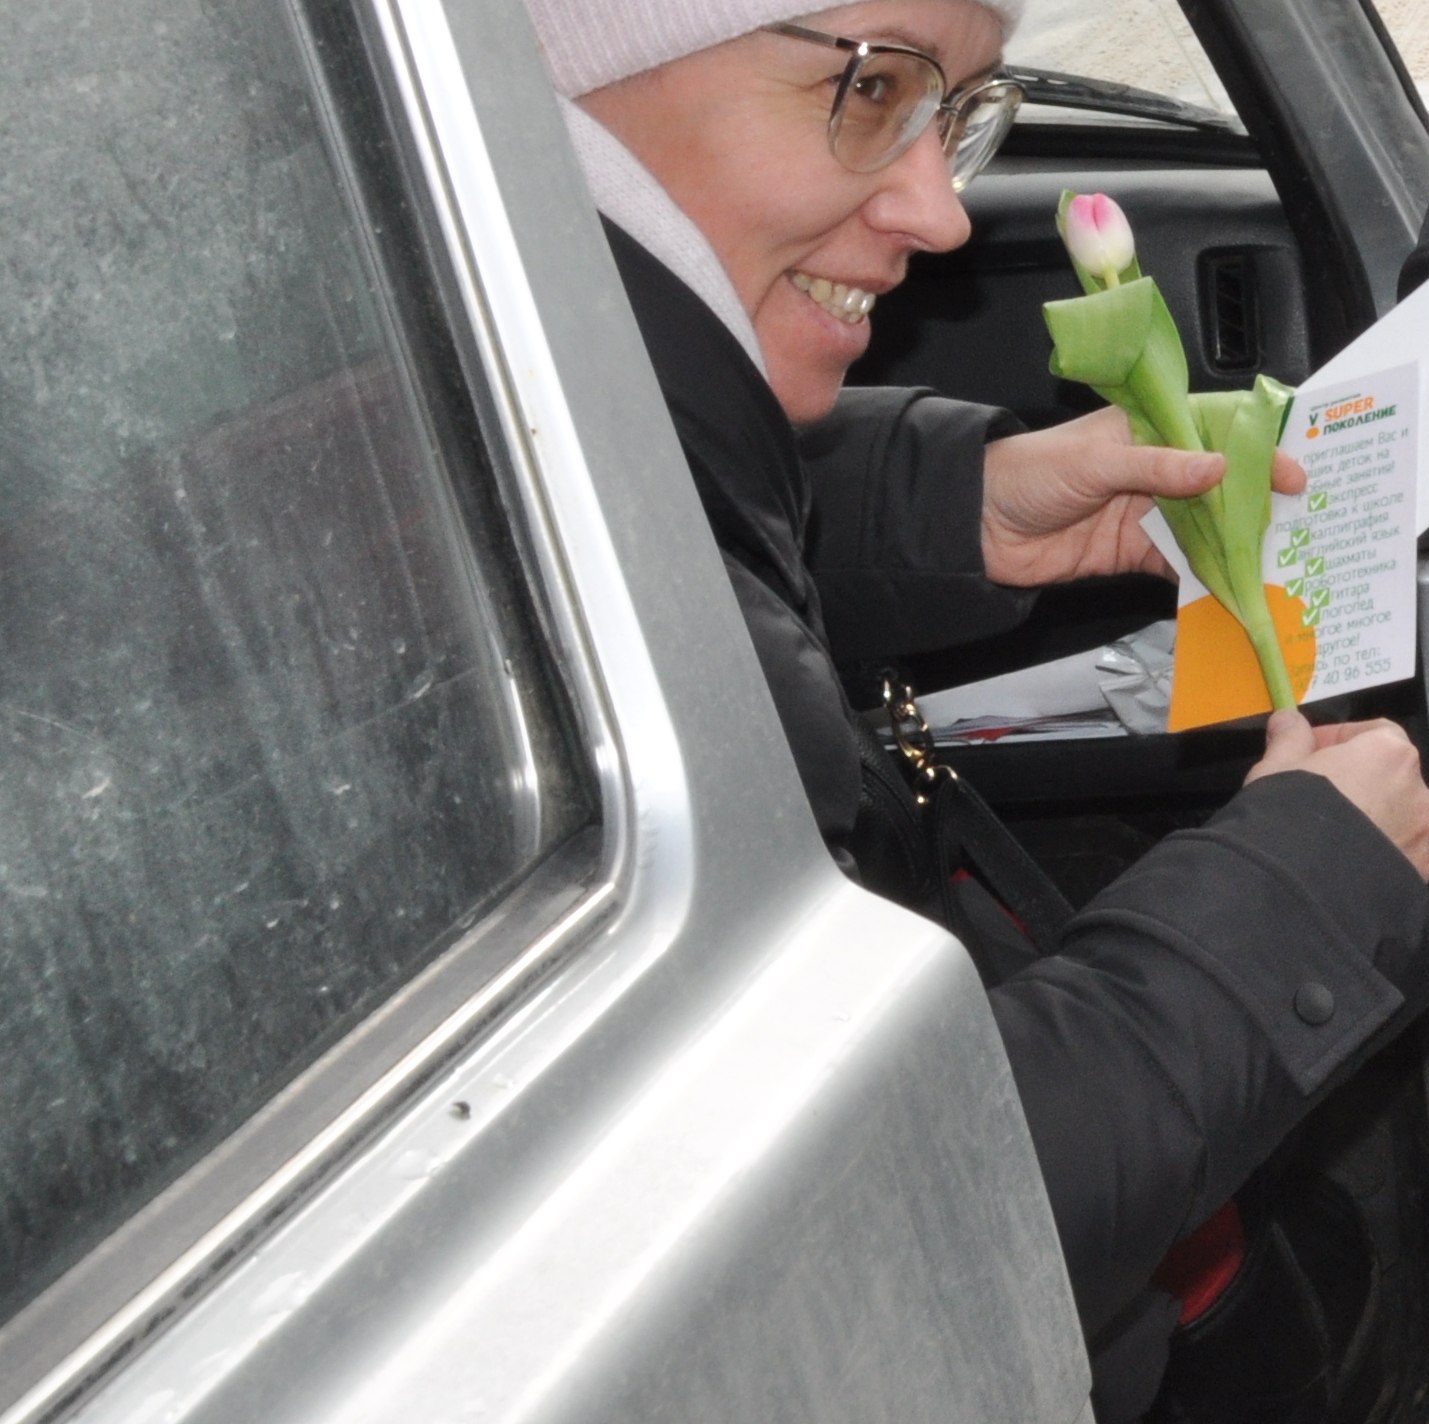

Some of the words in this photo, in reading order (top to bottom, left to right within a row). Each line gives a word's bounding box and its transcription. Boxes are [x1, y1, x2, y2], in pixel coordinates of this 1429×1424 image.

[1323, 404, 1397, 435] ПОКОЛЕНИЕ
[1324, 396, 1374, 422] SUPER
[1303, 437, 1374, 466] приглашаем
[1378, 430, 1397, 444] Вас
[1401, 428, 1409, 439] и
[1306, 465, 1333, 479] аших
[1338, 453, 1373, 475] деток
[1377, 448, 1390, 460] на
[1347, 460, 1395, 483] занятия!
[1328, 482, 1378, 505] экспресс
[1275, 506, 1347, 534] подготовка
[1352, 504, 1358, 514] к
[1363, 492, 1404, 512] школе
[1311, 511, 1389, 540] каллиграфия
[1297, 533, 1367, 561] английский
[1372, 526, 1400, 541] язык
[1325, 549, 1377, 570] шахматы
[1304, 560, 1396, 597] робототехника
[1331, 583, 1370, 601] гитара
[1321, 597, 1375, 619] логопед
[1347, 611, 1392, 629] многое
[1334, 655, 1351, 667] по
[1356, 646, 1381, 661] тел:
[1323, 670, 1340, 685] 40
[1344, 666, 1361, 681] 96
[1365, 658, 1392, 676] 555
